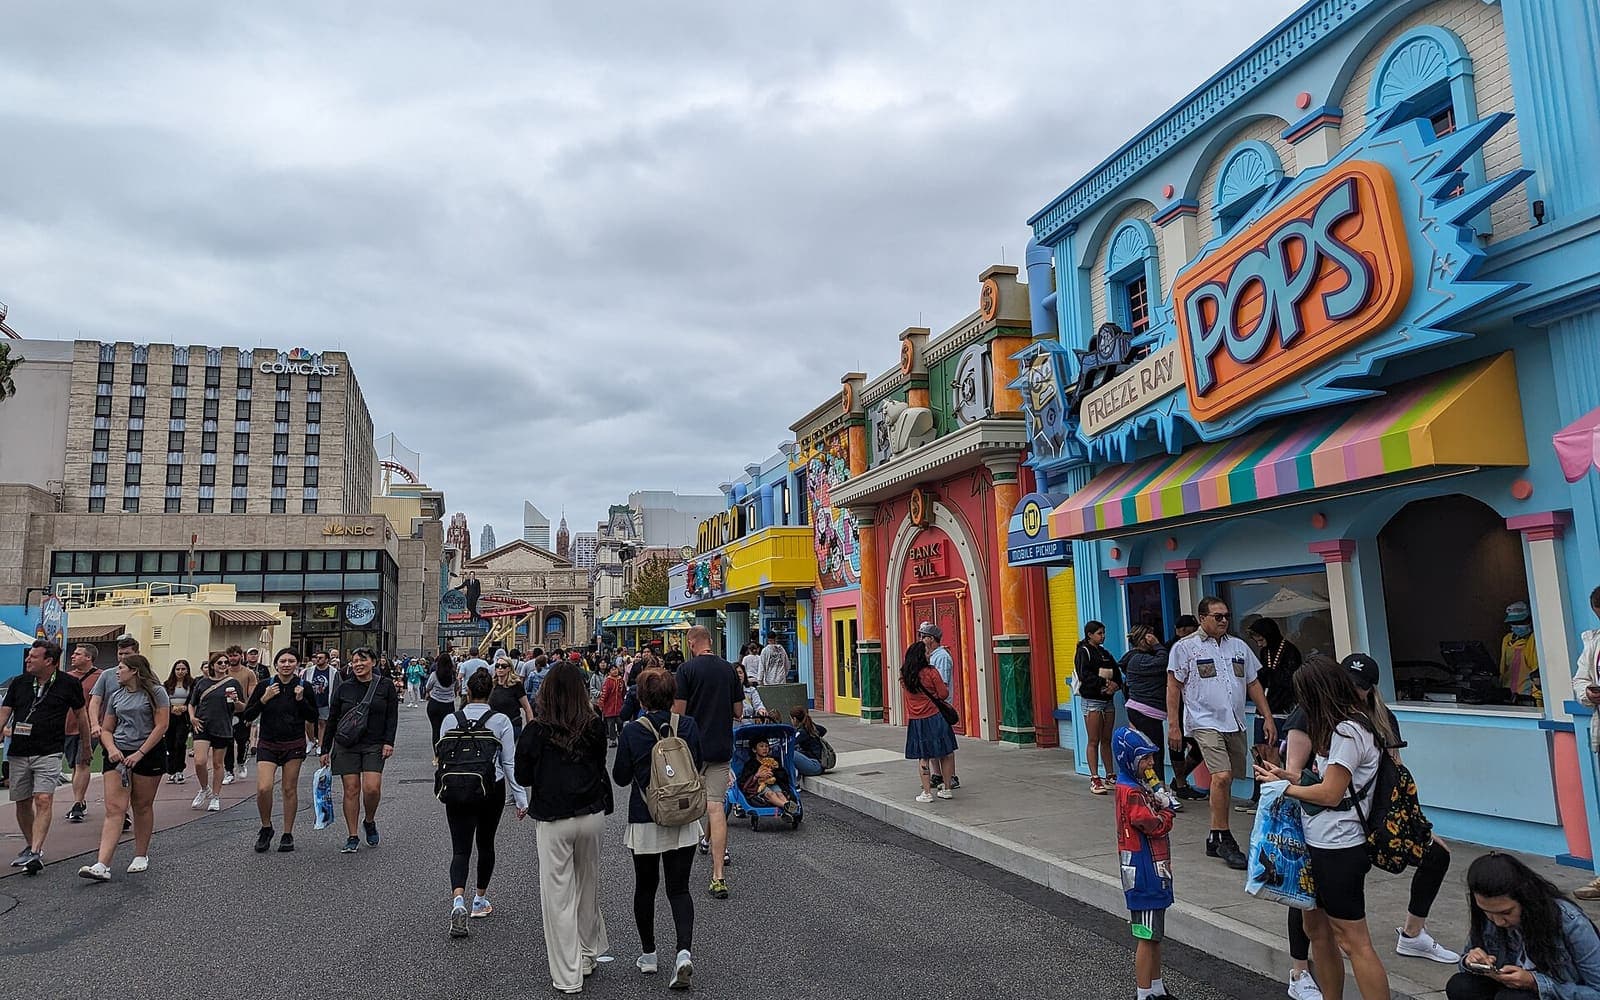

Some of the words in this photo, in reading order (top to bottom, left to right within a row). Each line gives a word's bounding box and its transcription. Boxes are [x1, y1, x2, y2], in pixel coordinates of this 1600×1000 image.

[1184, 177, 1374, 397] POPS
[260, 361, 339, 376] COMCAST
[1087, 375, 1139, 427] FREEZE
[1140, 350, 1174, 395] RAY
[344, 525, 375, 536] NBC
[909, 543, 939, 559] BANK
[1011, 547, 1033, 560] MOBILE
[1035, 543, 1057, 556] PICKUP
[913, 562, 935, 577] EVIL
